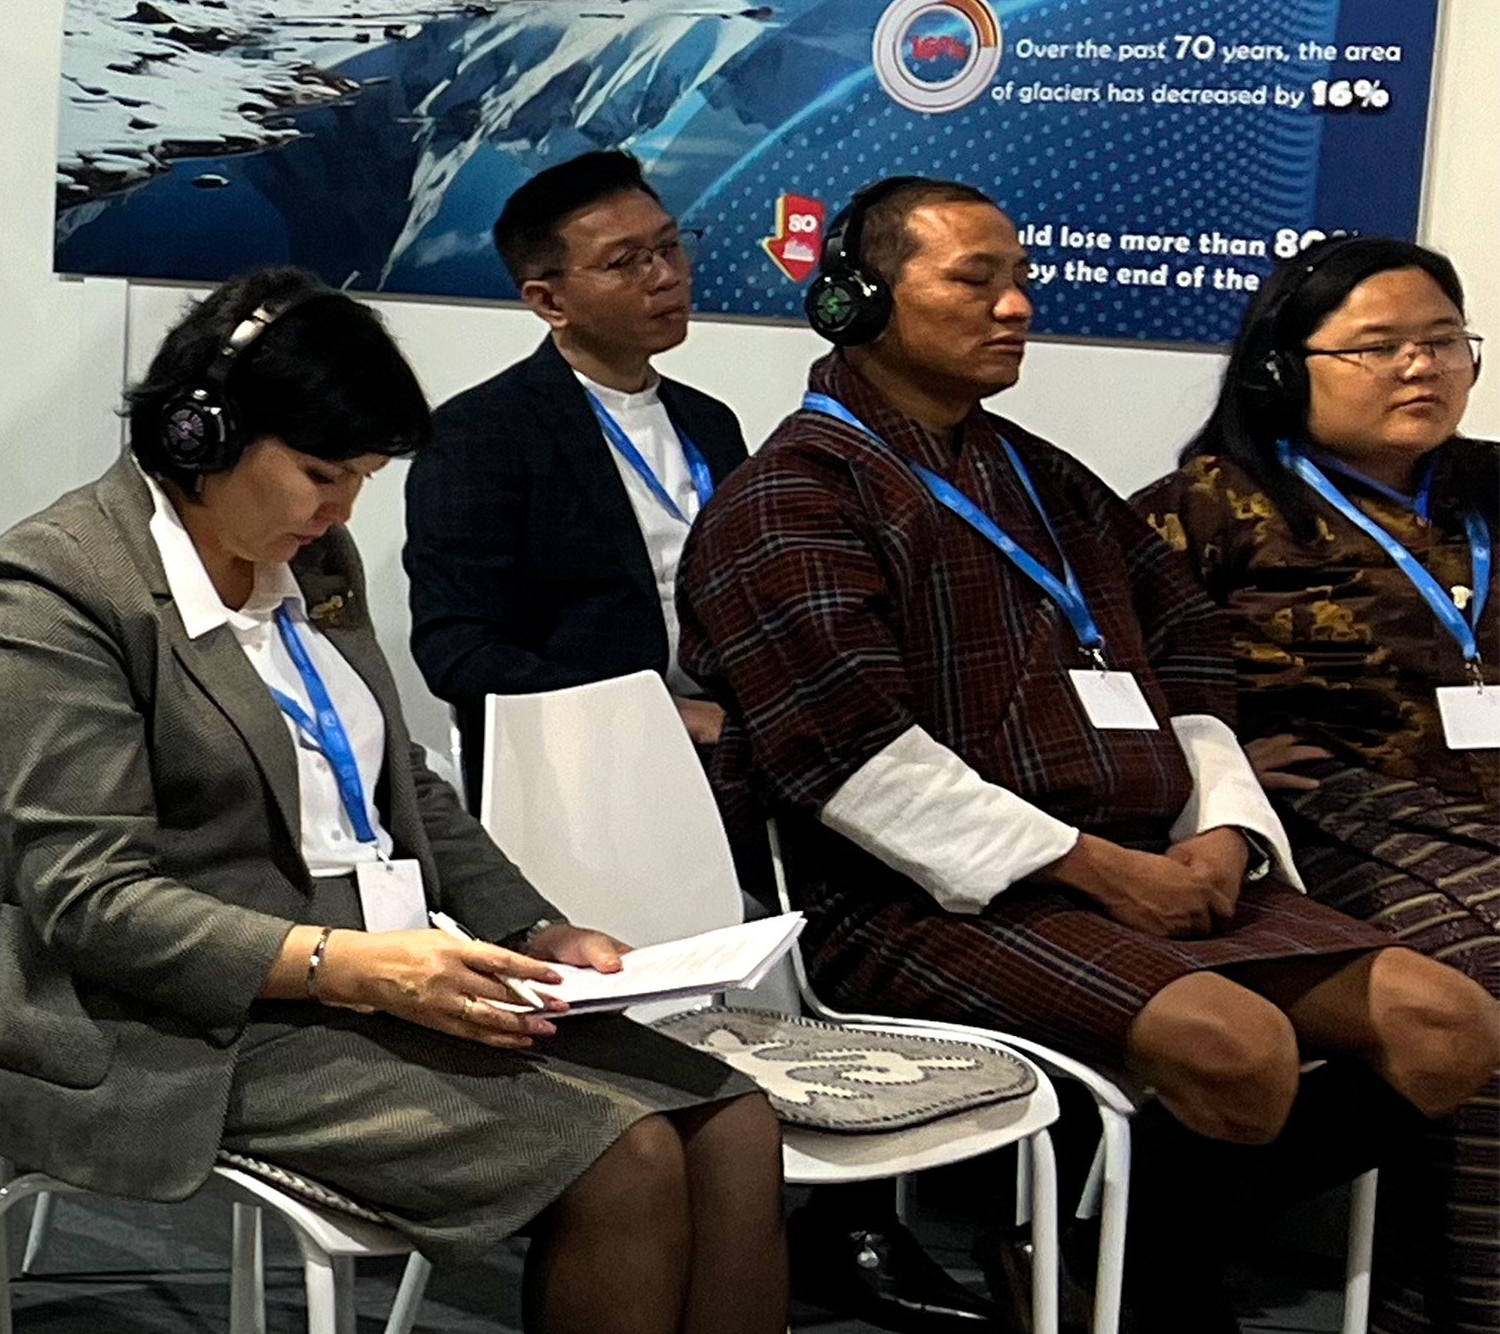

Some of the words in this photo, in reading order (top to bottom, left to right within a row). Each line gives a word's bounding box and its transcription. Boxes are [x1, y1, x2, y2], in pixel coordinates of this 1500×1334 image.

[1016, 38, 1069, 58] Over
[1075, 38, 1112, 59] the
[1118, 41, 1167, 62] past
[1174, 34, 1216, 60] 70
[1222, 43, 1290, 64] years,
[1298, 40, 1337, 61] the
[1344, 44, 1402, 62] area
[991, 80, 1016, 101] of
[1018, 80, 1101, 104] glaciers
[1107, 83, 1145, 103] has
[1151, 83, 1268, 105] decreased
[1274, 84, 1305, 109] by
[1311, 78, 1390, 108] 16%
[788, 213, 818, 233] 80
[1061, 225, 1112, 249] lose
[1120, 234, 1190, 253] more
[1199, 231, 1266, 257] than
[1064, 259, 1109, 283] the
[1116, 264, 1168, 286] end
[1176, 265, 1205, 288] of
[1213, 267, 1260, 291] the
